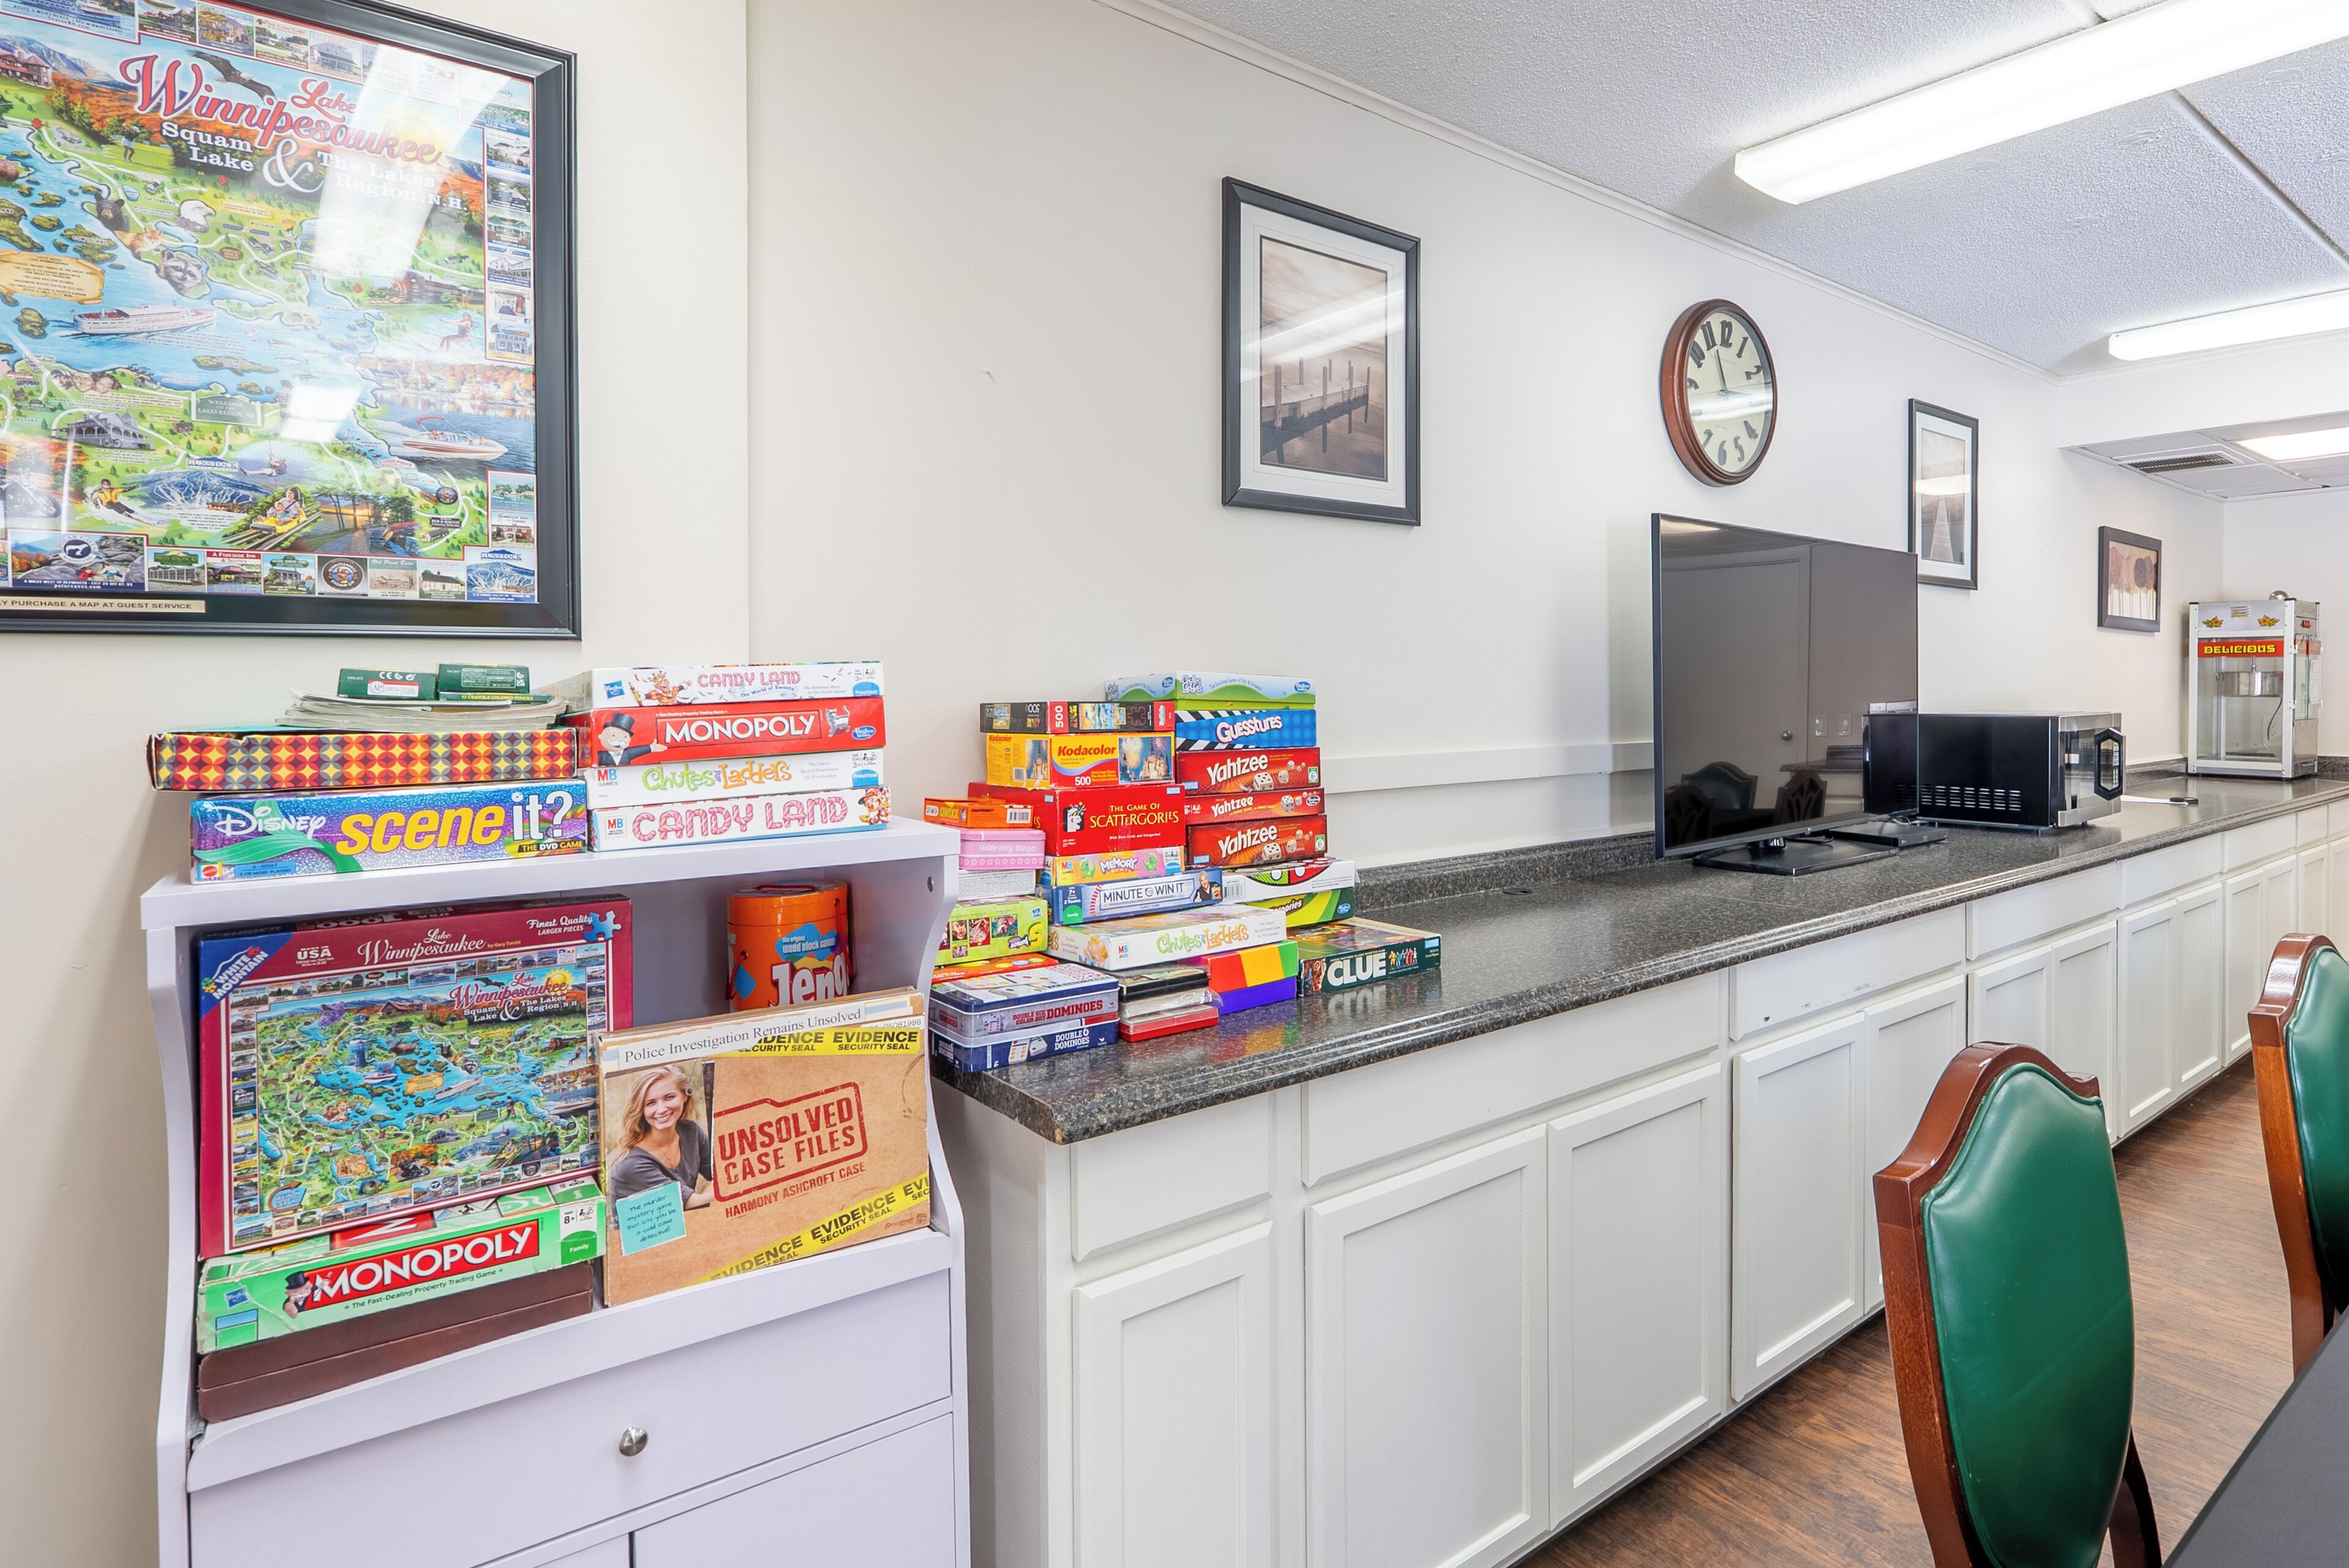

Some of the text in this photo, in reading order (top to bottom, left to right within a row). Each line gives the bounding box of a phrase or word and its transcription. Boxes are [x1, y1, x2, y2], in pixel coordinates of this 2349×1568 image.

[120, 54, 443, 166] Winnipesaukee
[291, 78, 358, 123] Lake
[161, 122, 253, 153] Squam
[189, 145, 254, 172] Lake
[263, 138, 324, 193] &
[317, 150, 436, 188] The Lakes
[1701, 320, 1718, 352] 11
[1720, 319, 1733, 349] 12
[1735, 336, 1750, 359] 1
[1744, 364, 1762, 380] 2
[1743, 420, 1759, 439] 4
[1717, 439, 1727, 467] 6
[1733, 435, 1745, 462] 5
[2203, 644, 2276, 654] DELICIOUS
[697, 670, 801, 688] CANDY LAND
[1054, 705, 1064, 728] 500
[664, 714, 815, 745] MONOPOLY
[1057, 744, 1116, 756] Kodacolor
[597, 769, 617, 782] MB
[642, 760, 792, 791] Chutes Ladders
[1074, 775, 1091, 786] 500
[1206, 754, 1269, 786] Yahtzee
[939, 806, 959, 819] QWIXX
[1149, 802, 1161, 810] OF
[1211, 796, 1254, 818] Yahtzee
[336, 791, 574, 856] scene it?
[607, 818, 624, 829] MB
[632, 796, 848, 842] CANDY LAND
[1089, 811, 1179, 829] SCATTERGORIES
[540, 842, 558, 851] DVD
[560, 840, 584, 849] GAME
[998, 844, 1014, 853] Kitty
[1218, 825, 1278, 857] Yahtzee
[1061, 860, 1073, 870] MB
[1099, 856, 1138, 874] MEMORY
[1103, 882, 1184, 903] MINUTE WIN IT
[527, 915, 593, 930] Finest Quality
[537, 926, 563, 936] LARGER
[423, 928, 452, 943] Lake
[1156, 923, 1249, 955] Chutes Ladders
[297, 949, 332, 960] USA
[357, 939, 486, 966] Winnipesaukee
[782, 944, 801, 954] wood
[1118, 945, 1128, 955] MB
[212, 950, 269, 1000] MOUNTAIN
[215, 954, 251, 985] WHITE
[513, 972, 538, 986] Lake
[1326, 951, 1387, 987] CLUE
[771, 952, 850, 1008] Jeng
[449, 977, 571, 1010] Winnipesaukee
[520, 994, 566, 1008] The Lakes
[464, 1005, 497, 1016] Squam
[473, 1012, 497, 1023] Lake
[499, 1000, 524, 1021] &
[1012, 1011, 1035, 1021] DOUBLE
[1047, 1000, 1104, 1019] DOMINOES
[625, 1008, 861, 1063] Police Investigation Remains Unsolved
[833, 1031, 918, 1043] EVIDENCE
[1054, 1036, 1090, 1051] DOMINOES
[1055, 1027, 1089, 1043] DOUBLE 6
[791, 1042, 910, 1052] SEAL SECURITY SEAL
[718, 1097, 854, 1161] UNSOLVED
[724, 1126, 856, 1186] CASE FILES
[643, 1195, 667, 1207] murder
[724, 1162, 866, 1219] HARMONY ASHCROFT CASE
[563, 1216, 576, 1224] 8+
[627, 1201, 672, 1222] mystery game
[627, 1221, 639, 1230] that
[642, 1216, 653, 1225] lets
[655, 1213, 667, 1222] you
[811, 1191, 897, 1241] EVIDENCE
[642, 1218, 673, 1233] cold case
[820, 1207, 892, 1245] SECURITY SEAL
[569, 1244, 590, 1253] Family
[313, 1226, 533, 1303] MONOPOLY
[368, 1290, 412, 1305] Fast-Dealing
[415, 1282, 447, 1293] Property
[448, 1274, 475, 1285] Trading
[476, 1270, 497, 1279] Game
